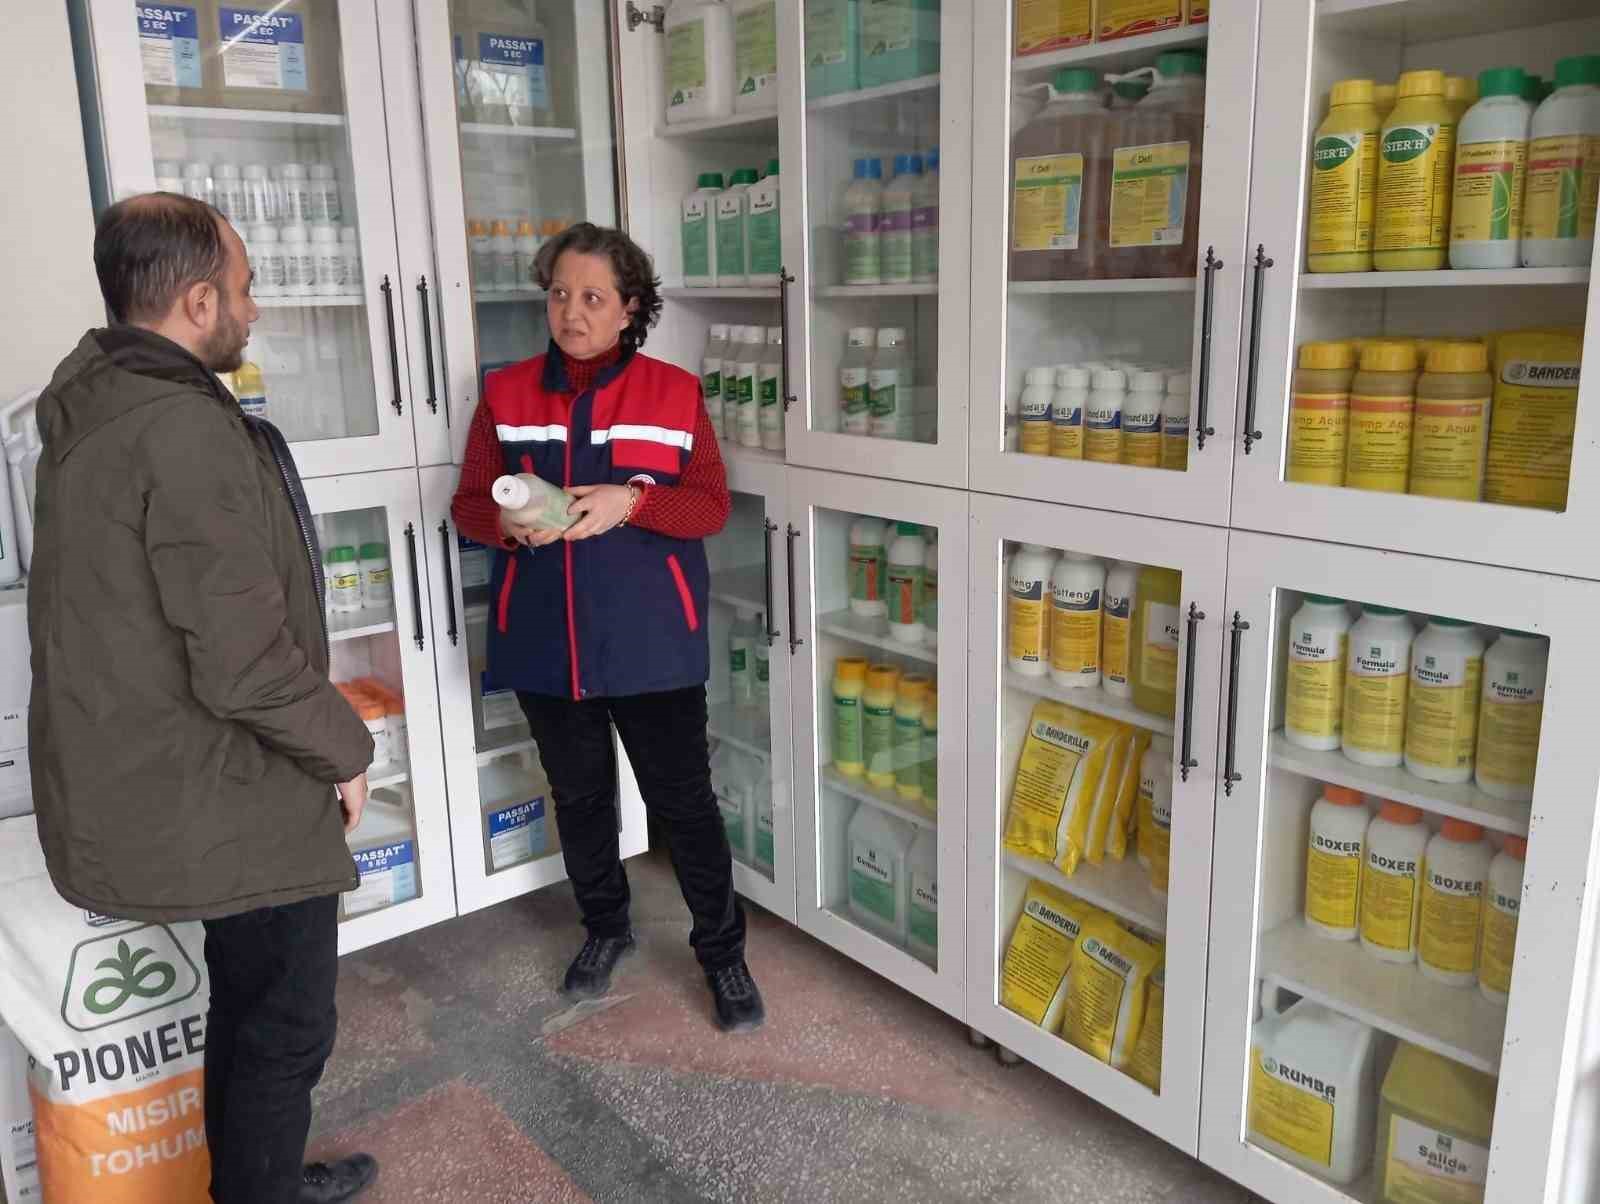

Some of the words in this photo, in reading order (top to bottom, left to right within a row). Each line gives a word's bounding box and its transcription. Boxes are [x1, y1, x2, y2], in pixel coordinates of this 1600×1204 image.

[135, 8, 182, 23] ASSAT
[233, 13, 288, 29] PASSAT
[489, 38, 535, 51] PASSAT
[1292, 641, 1325, 655] Formula
[1356, 656, 1395, 669] Formula
[498, 802, 537, 824] PASSAT
[1316, 836, 1360, 852] BOXER
[1371, 853, 1416, 873] BOXER
[1434, 874, 1482, 892] BOXER
[1498, 895, 1520, 910] BO
[54, 1014, 208, 1092] PIONEE
[1279, 1063, 1336, 1098] RUMBA
[105, 1087, 200, 1137] MISIR
[1418, 1144, 1468, 1173] Salida
